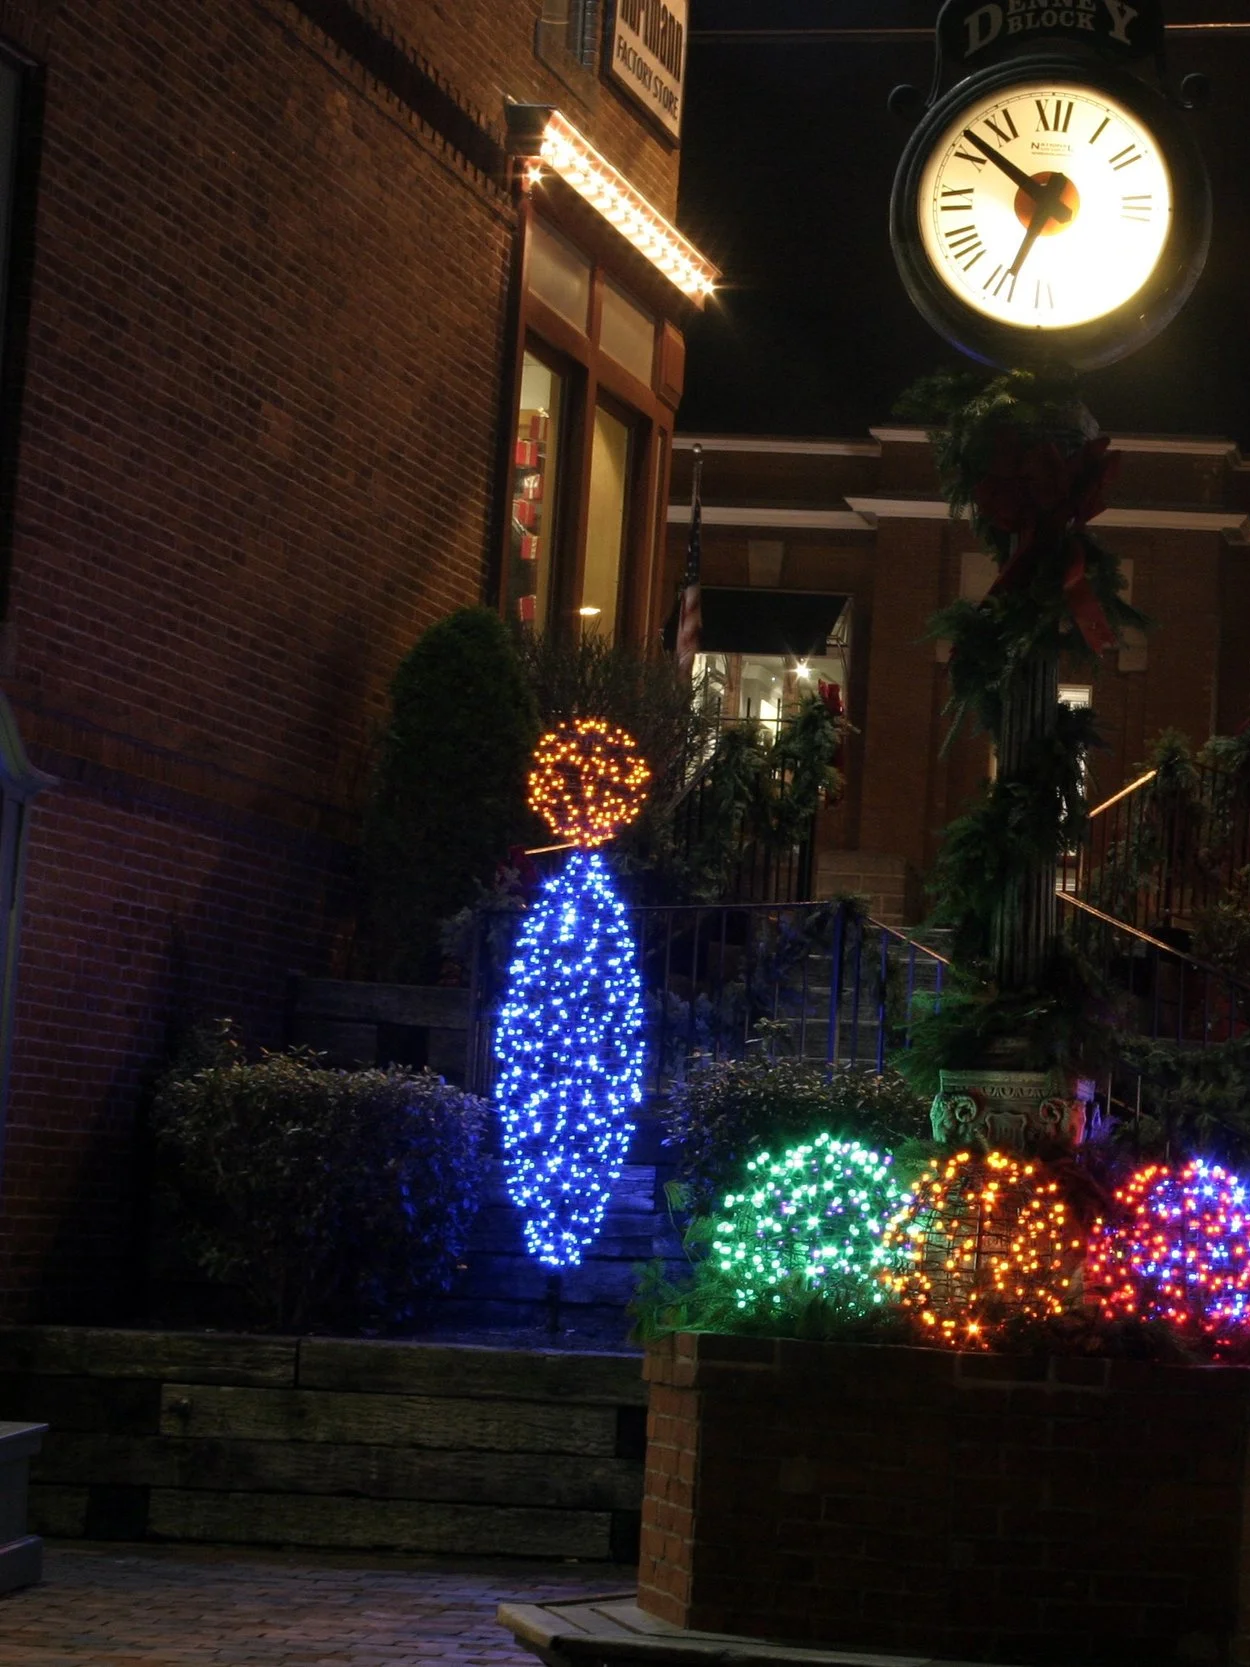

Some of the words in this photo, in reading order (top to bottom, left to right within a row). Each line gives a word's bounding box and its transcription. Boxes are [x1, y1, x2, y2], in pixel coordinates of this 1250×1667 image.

[1006, 10, 1096, 35] BLOCK
[616, 34, 654, 92] FACTORY
[653, 76, 680, 121] STORE
[982, 107, 1020, 149] XI
[1034, 99, 1075, 133] XII
[953, 143, 988, 173] X
